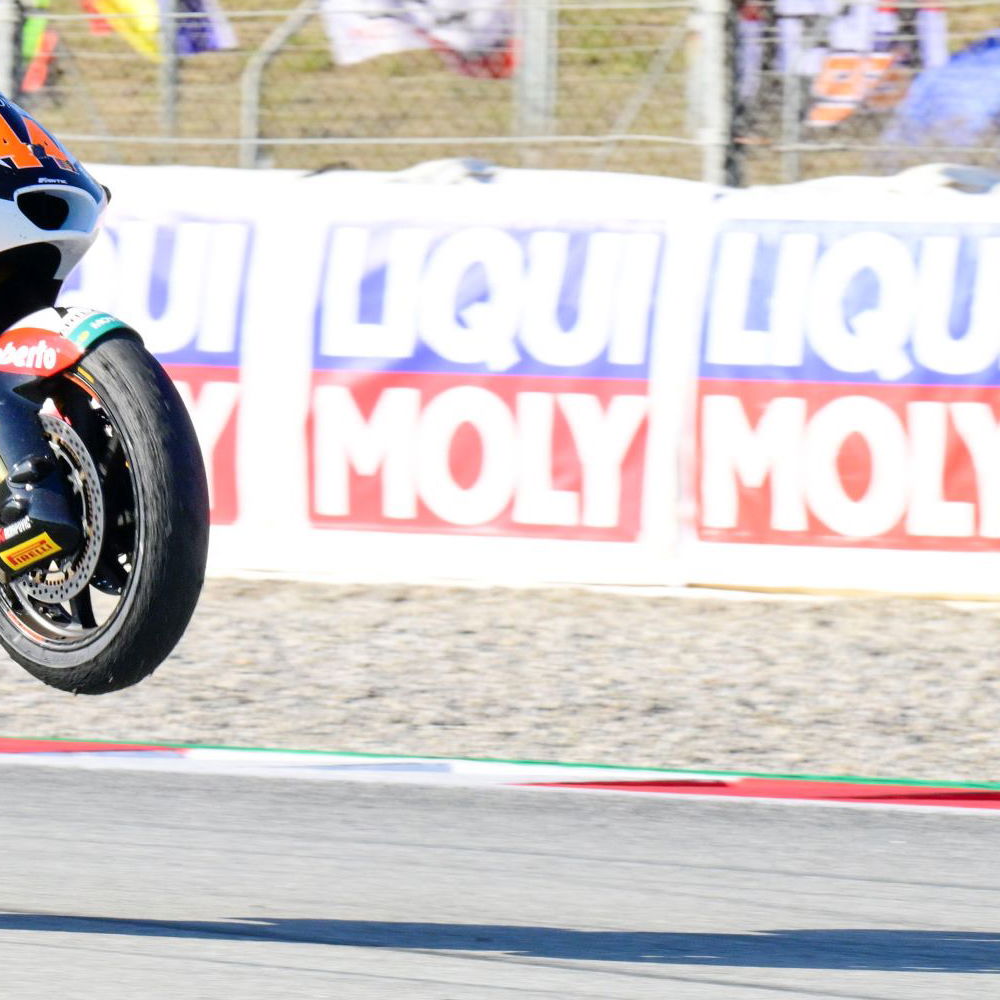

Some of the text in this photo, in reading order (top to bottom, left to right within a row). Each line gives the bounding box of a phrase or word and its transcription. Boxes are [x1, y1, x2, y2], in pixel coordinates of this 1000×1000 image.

[318, 226, 662, 372] LIQUI
[312, 385, 651, 528] MOLY
[8, 540, 53, 567] PIRELLI
